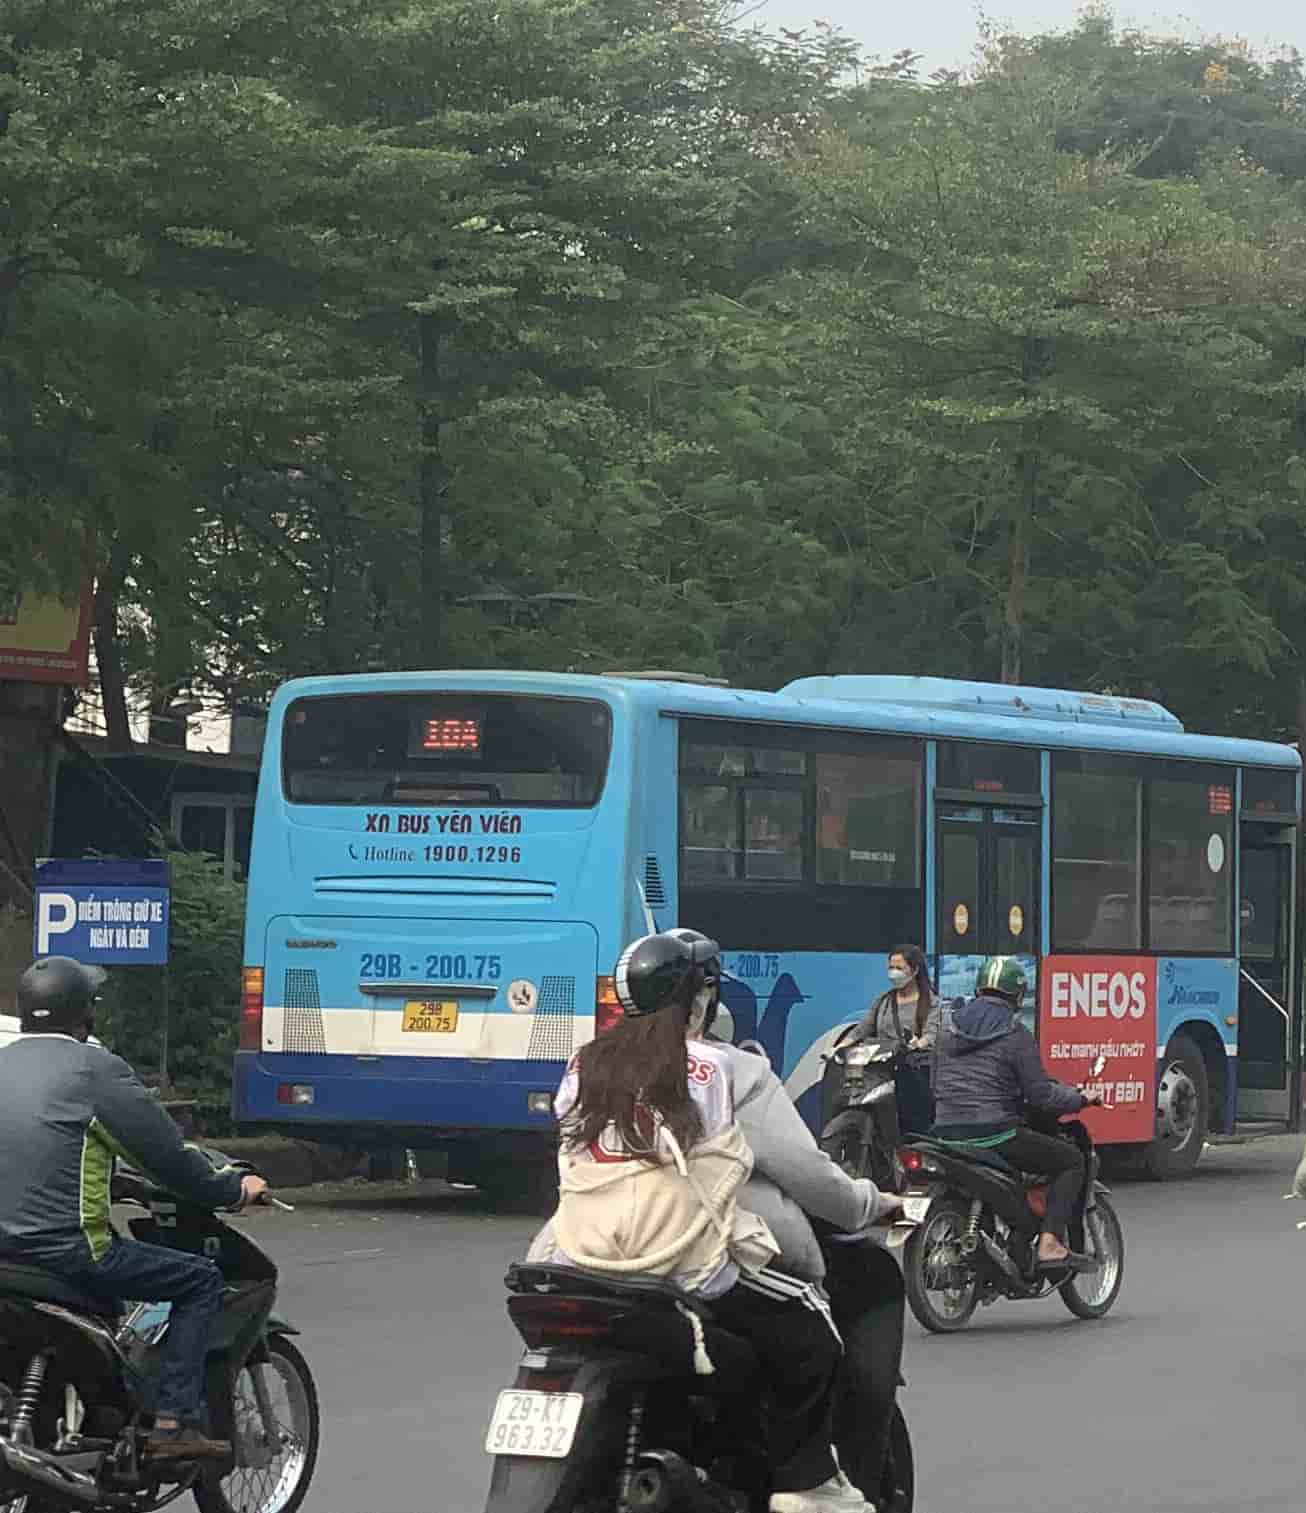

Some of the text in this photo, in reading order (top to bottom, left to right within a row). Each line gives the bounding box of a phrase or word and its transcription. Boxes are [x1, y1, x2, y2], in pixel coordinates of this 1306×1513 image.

[365, 810, 522, 834] XN BUS YÊN VIÊN
[424, 846, 521, 863] 1900.1296
[38, 892, 76, 954] P
[151, 901, 162, 922] XE
[360, 953, 401, 978] 29B
[425, 956, 501, 979] 200.75
[1051, 971, 1146, 1018] ENEOS
